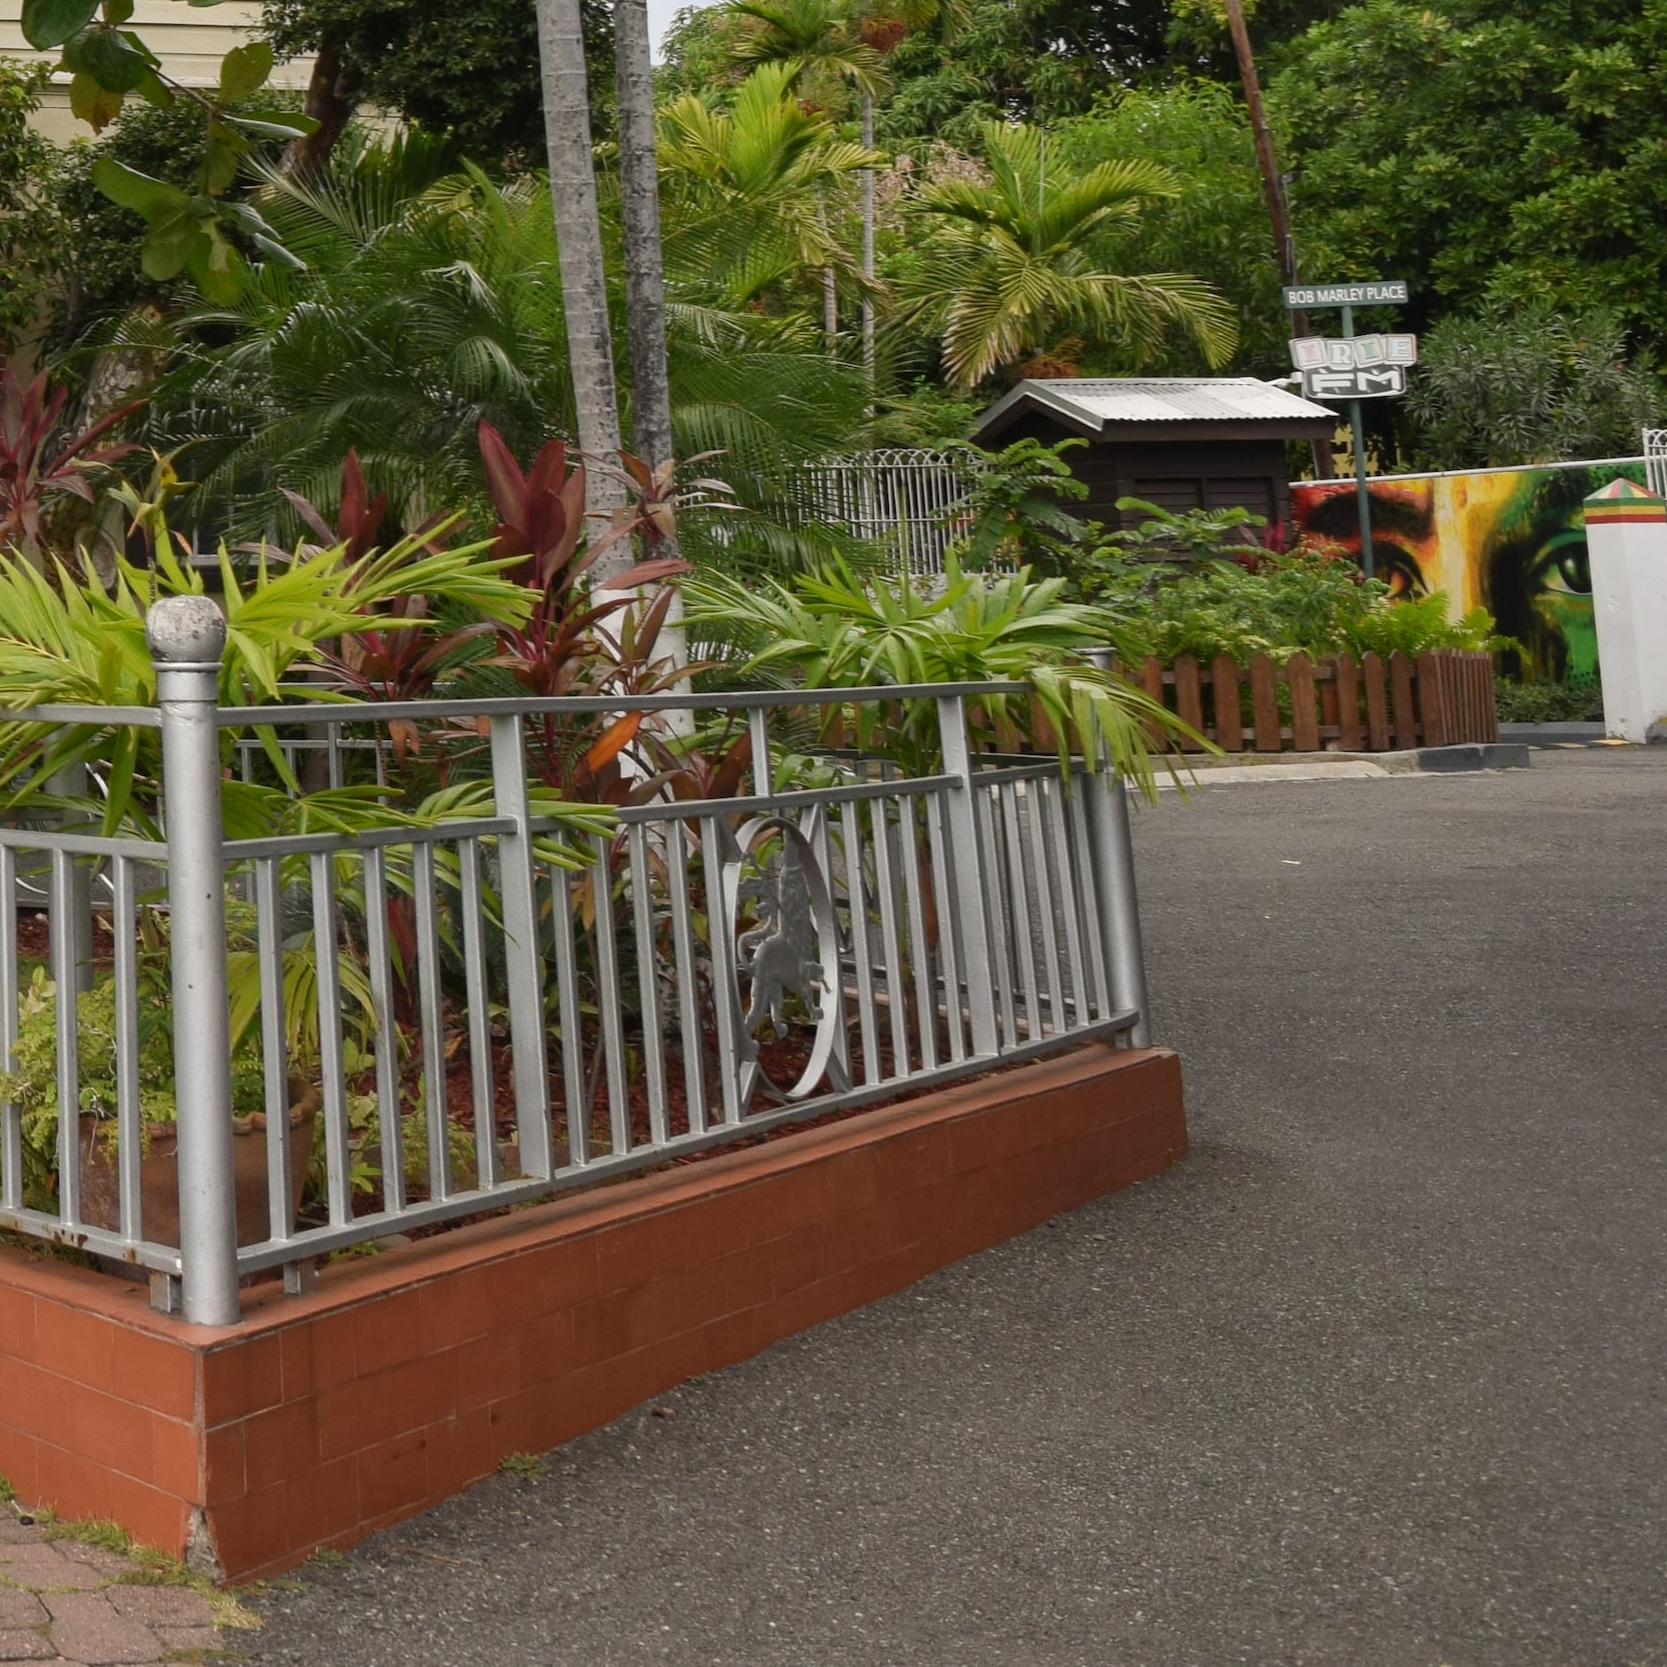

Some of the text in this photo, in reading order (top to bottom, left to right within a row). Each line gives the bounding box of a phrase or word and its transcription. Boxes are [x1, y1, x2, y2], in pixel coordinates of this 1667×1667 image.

[1288, 285, 1406, 304] BOB MARLEY PLACE
[1296, 338, 1413, 367] IRIE
[1311, 370, 1402, 392] FM
